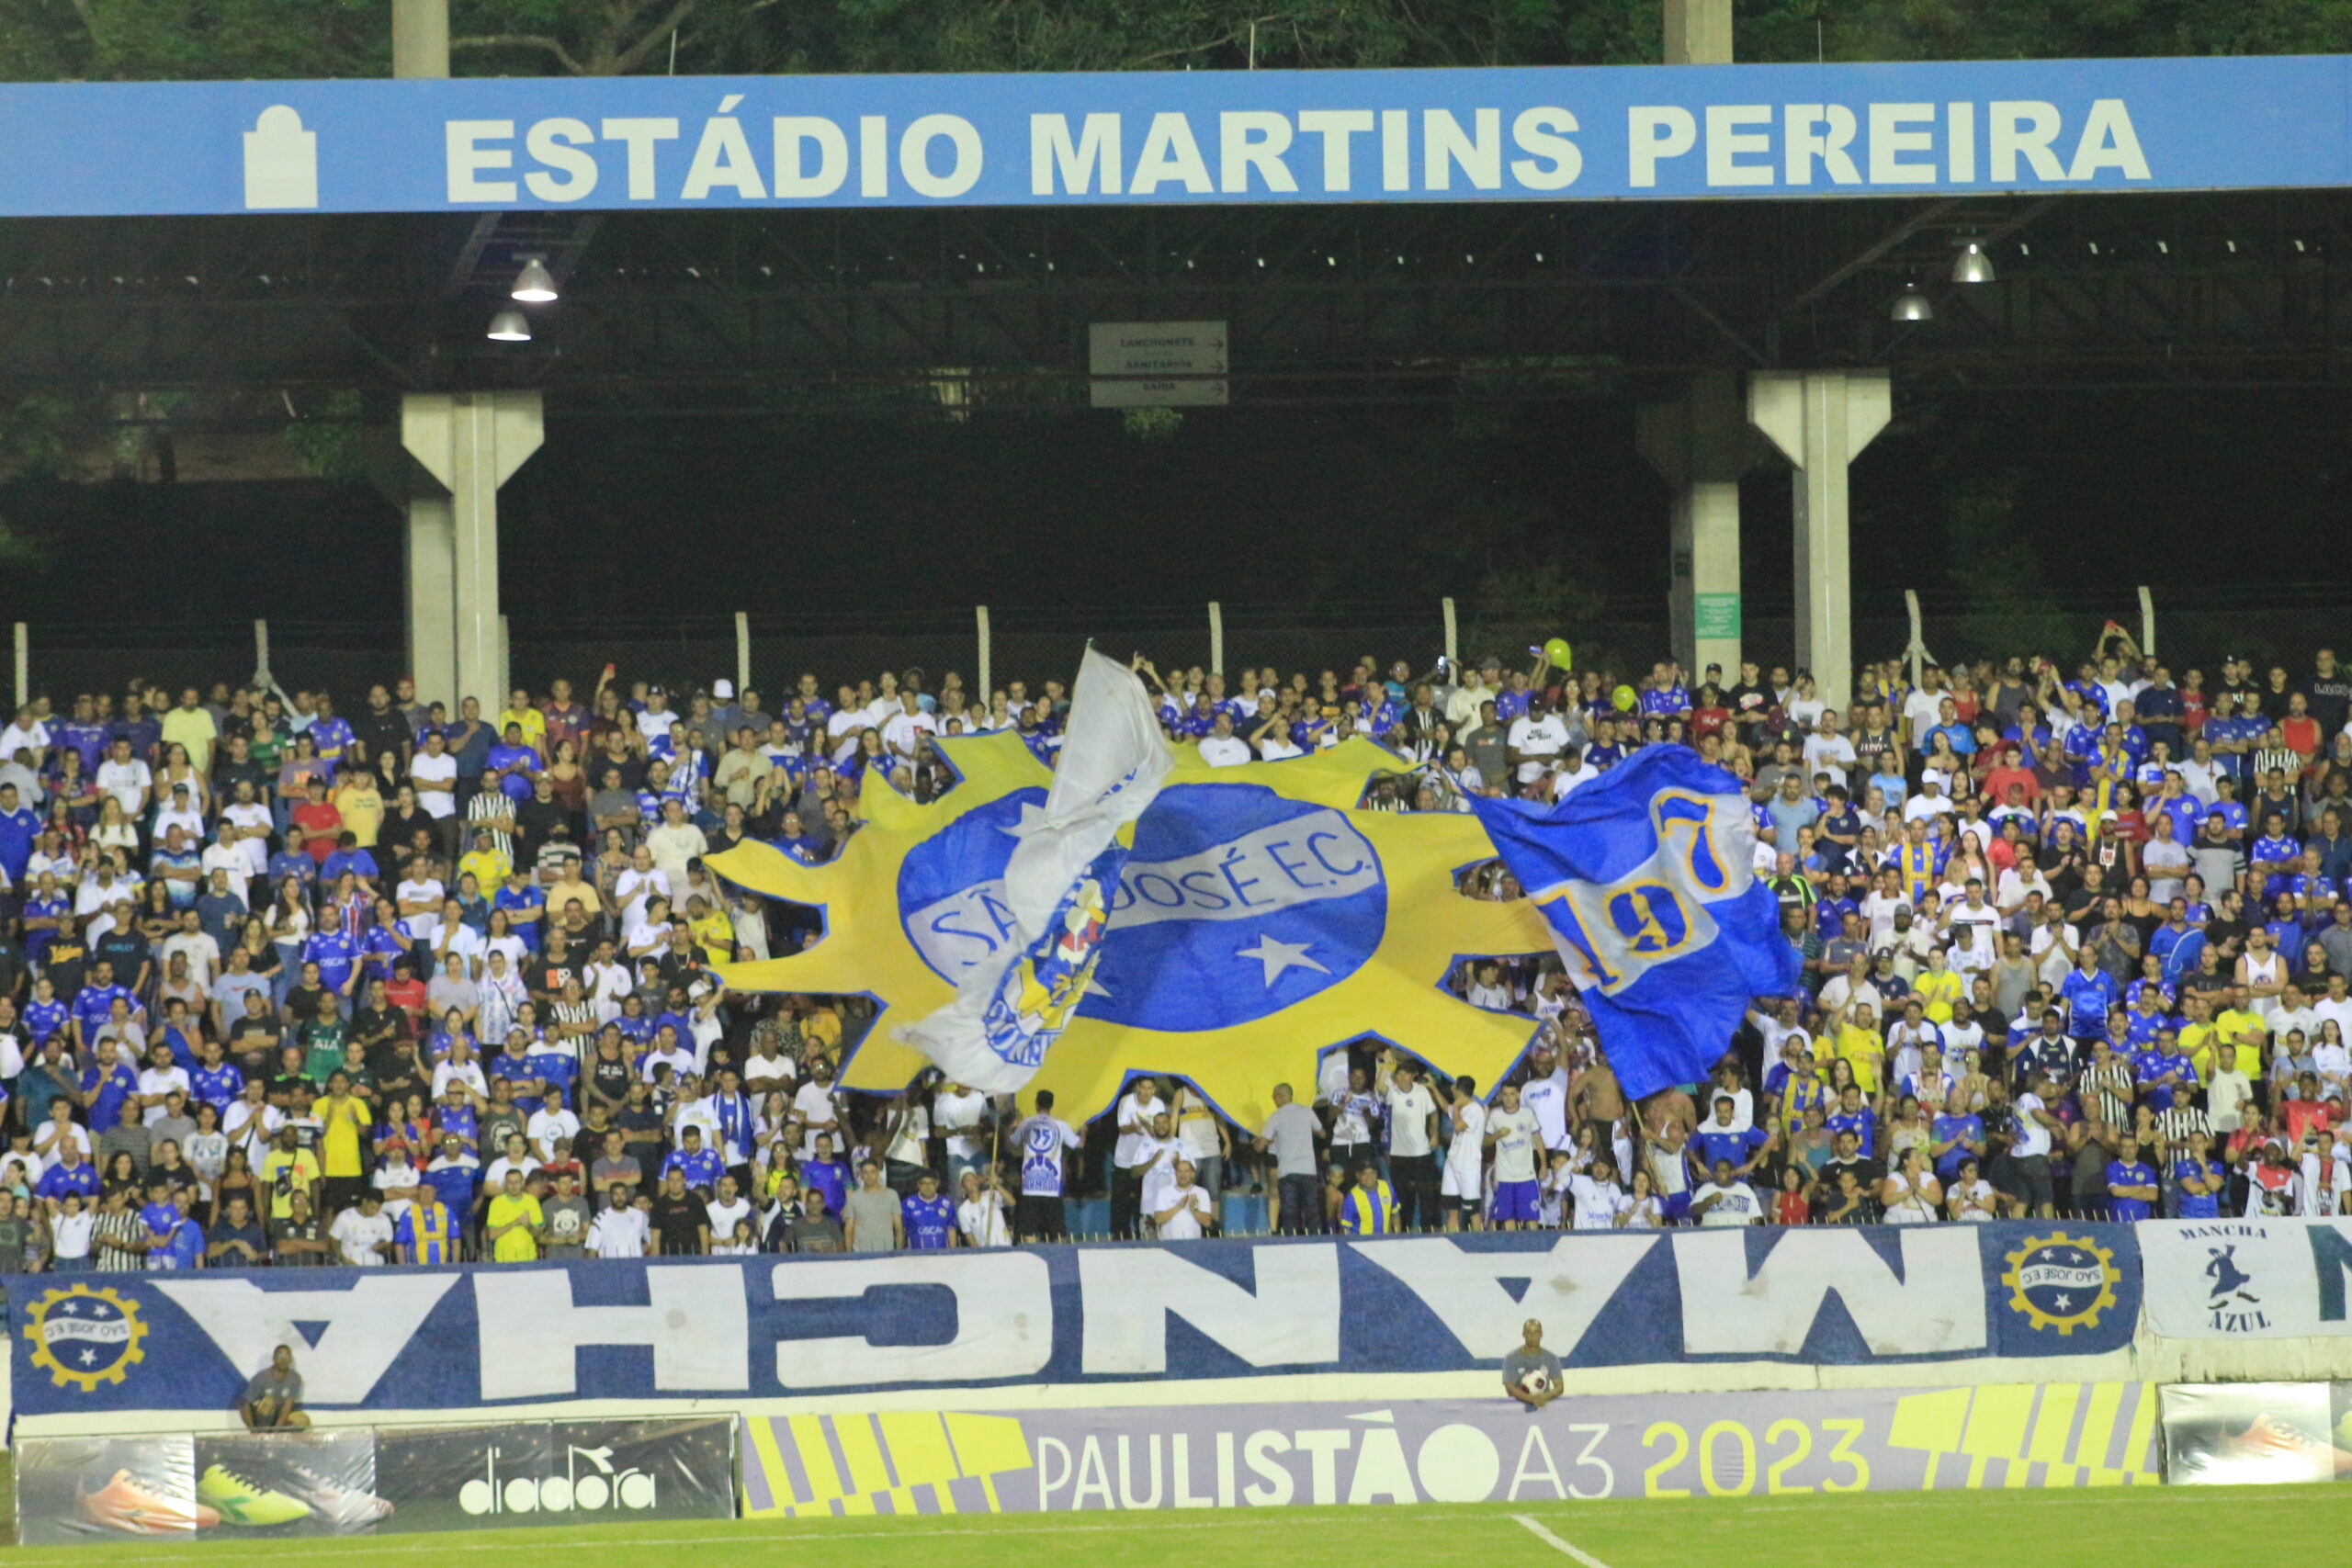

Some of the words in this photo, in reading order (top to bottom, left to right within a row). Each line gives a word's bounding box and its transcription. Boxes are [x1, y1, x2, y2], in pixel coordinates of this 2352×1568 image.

[446, 94, 983, 203] ESTÁDIO
[1030, 106, 1583, 196] MARTINS
[1628, 98, 2152, 187] PEREIRA
[2178, 1224, 2267, 1241] MANCHA
[2208, 1310, 2271, 1333] AZUL
[458, 1444, 656, 1515] diadora
[1037, 1408, 1500, 1513] PAULISTÃO
[1507, 1422, 1615, 1503] A3
[1641, 1417, 1871, 1499] 2023
